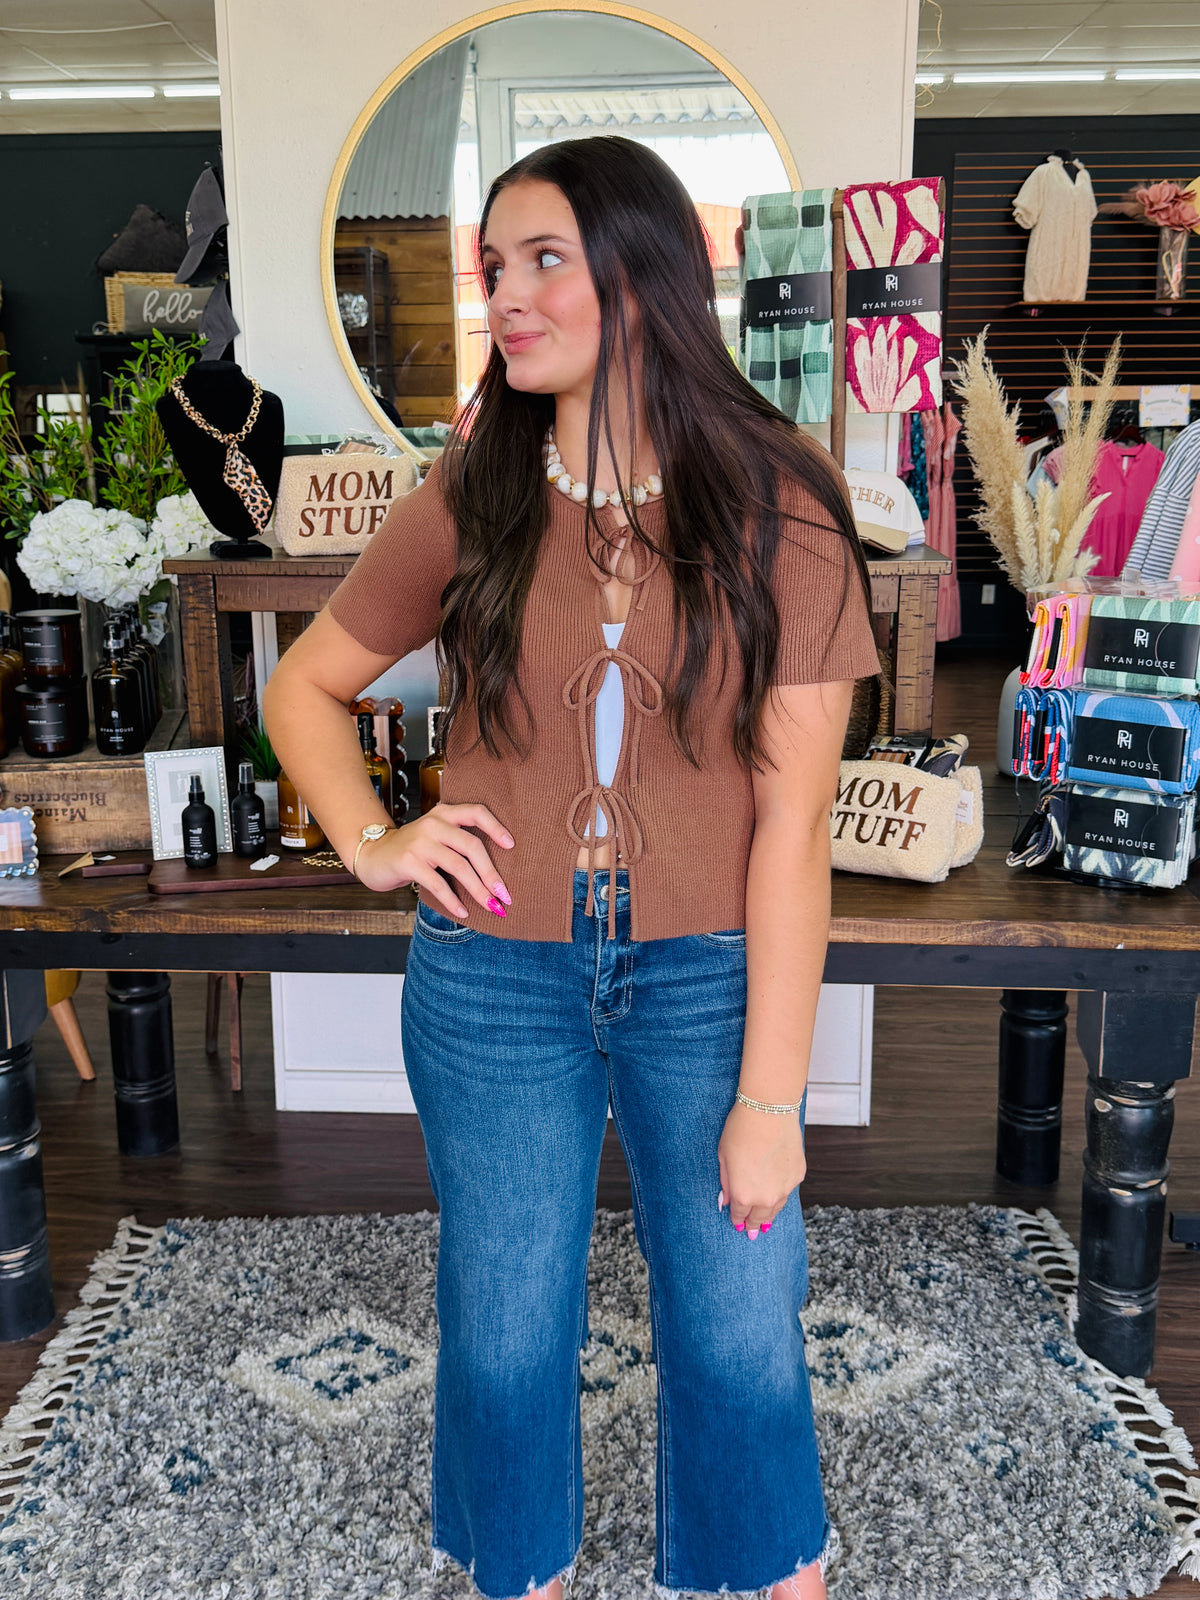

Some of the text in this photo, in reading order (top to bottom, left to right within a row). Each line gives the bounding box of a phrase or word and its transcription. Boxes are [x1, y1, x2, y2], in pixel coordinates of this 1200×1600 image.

[143, 289, 203, 323] hello
[758, 306, 815, 318] RYAN HOUSE
[862, 298, 924, 310] RYAN HOUSE
[306, 470, 394, 502] MOM
[848, 486, 895, 514] THER
[299, 504, 391, 537] STUF
[1103, 654, 1176, 670] RYAN HOUSE
[1087, 754, 1159, 771] RYAN HOUSE
[835, 776, 924, 815] MOM
[830, 810, 927, 850] TUFF
[1084, 832, 1156, 851] RYAN HOUSE
